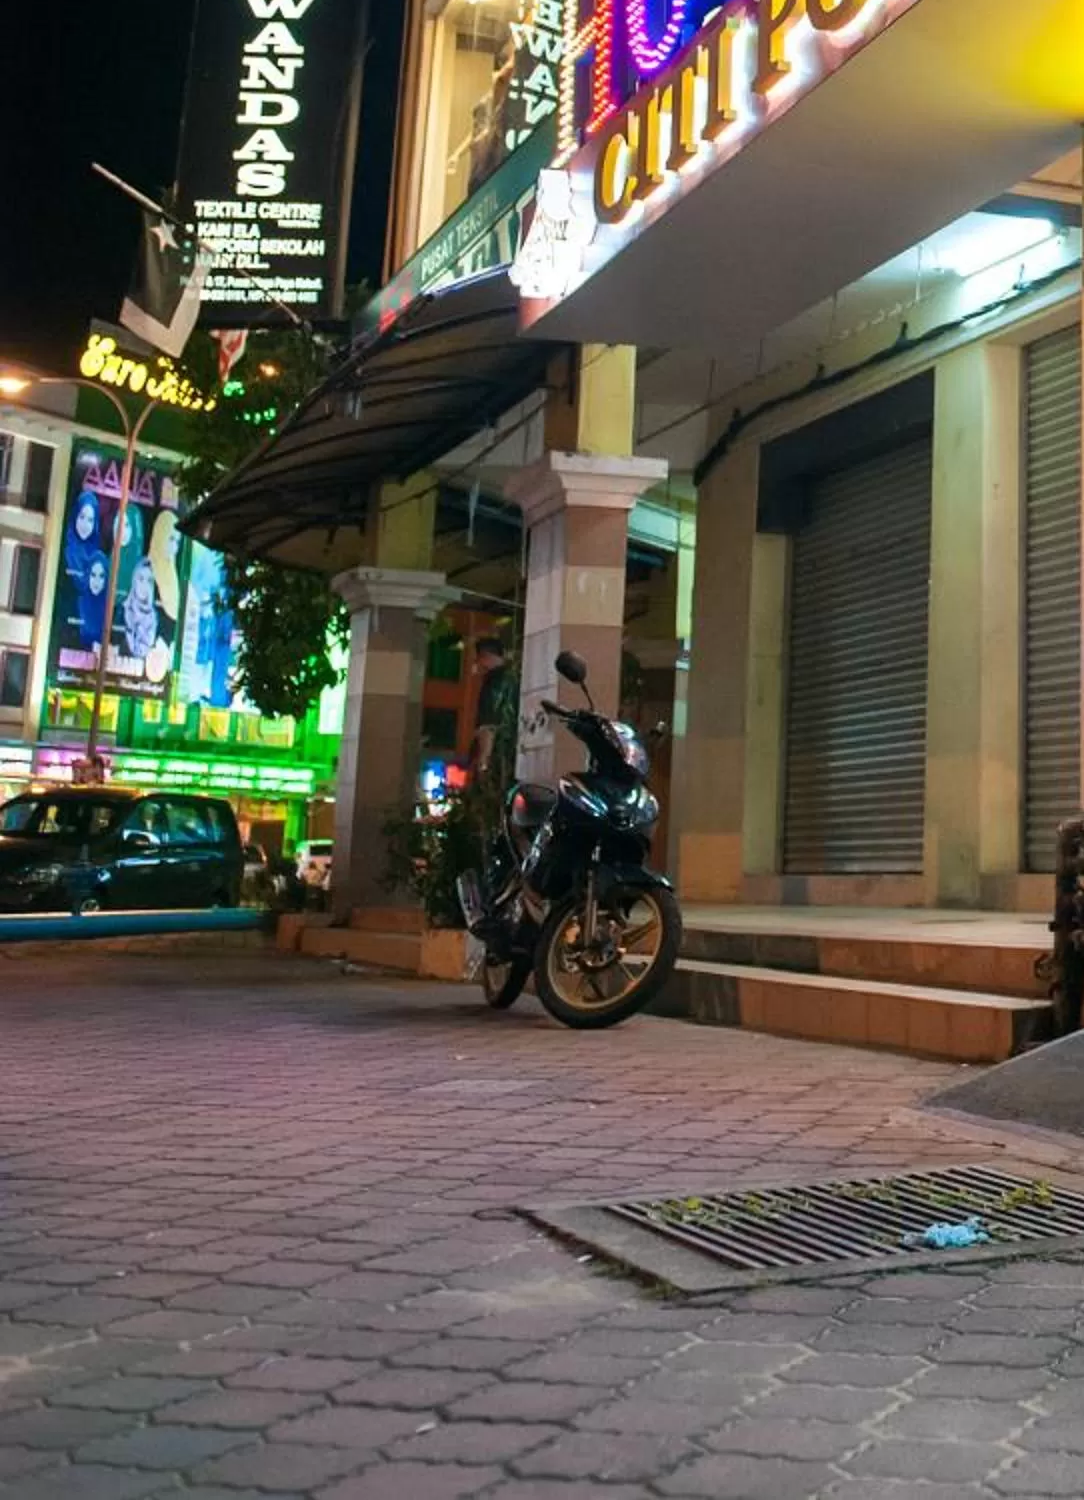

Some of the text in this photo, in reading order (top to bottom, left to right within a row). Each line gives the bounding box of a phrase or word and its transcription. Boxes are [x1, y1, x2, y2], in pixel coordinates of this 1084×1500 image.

[594, 13, 754, 224] CITI
[194, 201, 322, 220] TEXTILE CENTRE
